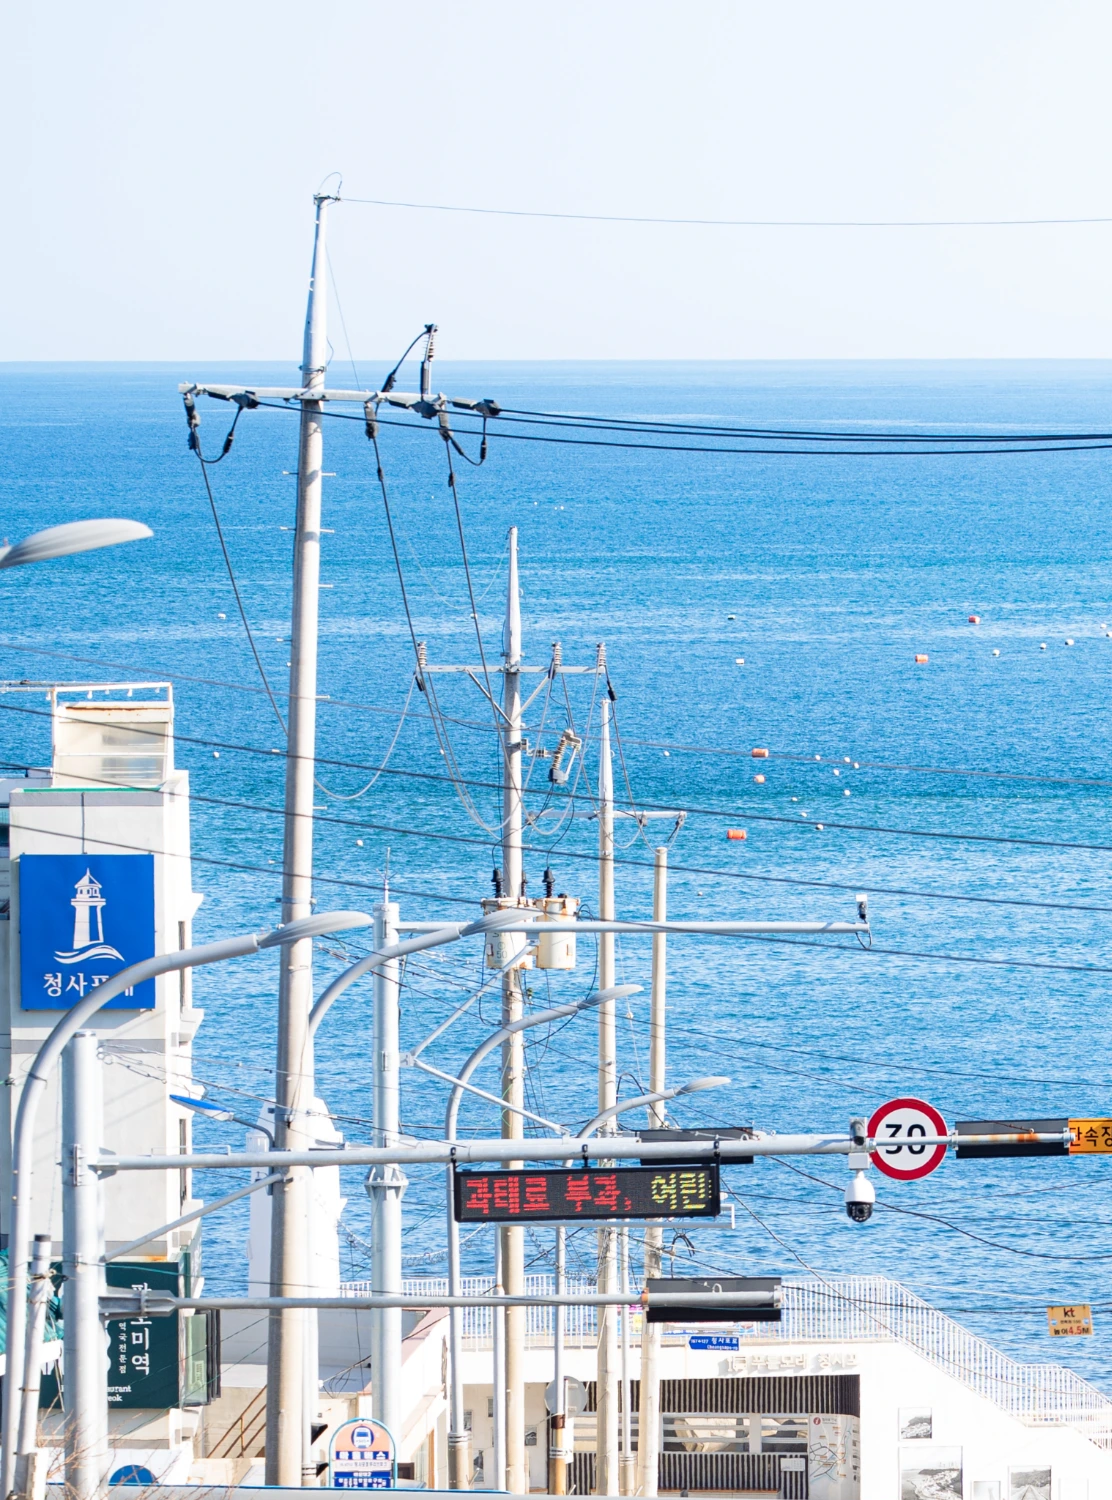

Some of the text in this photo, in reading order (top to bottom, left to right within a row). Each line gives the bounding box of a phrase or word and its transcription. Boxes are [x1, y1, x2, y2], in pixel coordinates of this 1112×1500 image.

[885, 1124, 926, 1154] 30
[466, 1177, 550, 1214] 과태료
[651, 1172, 712, 1210] 어린
[1063, 1307, 1076, 1318] kt
